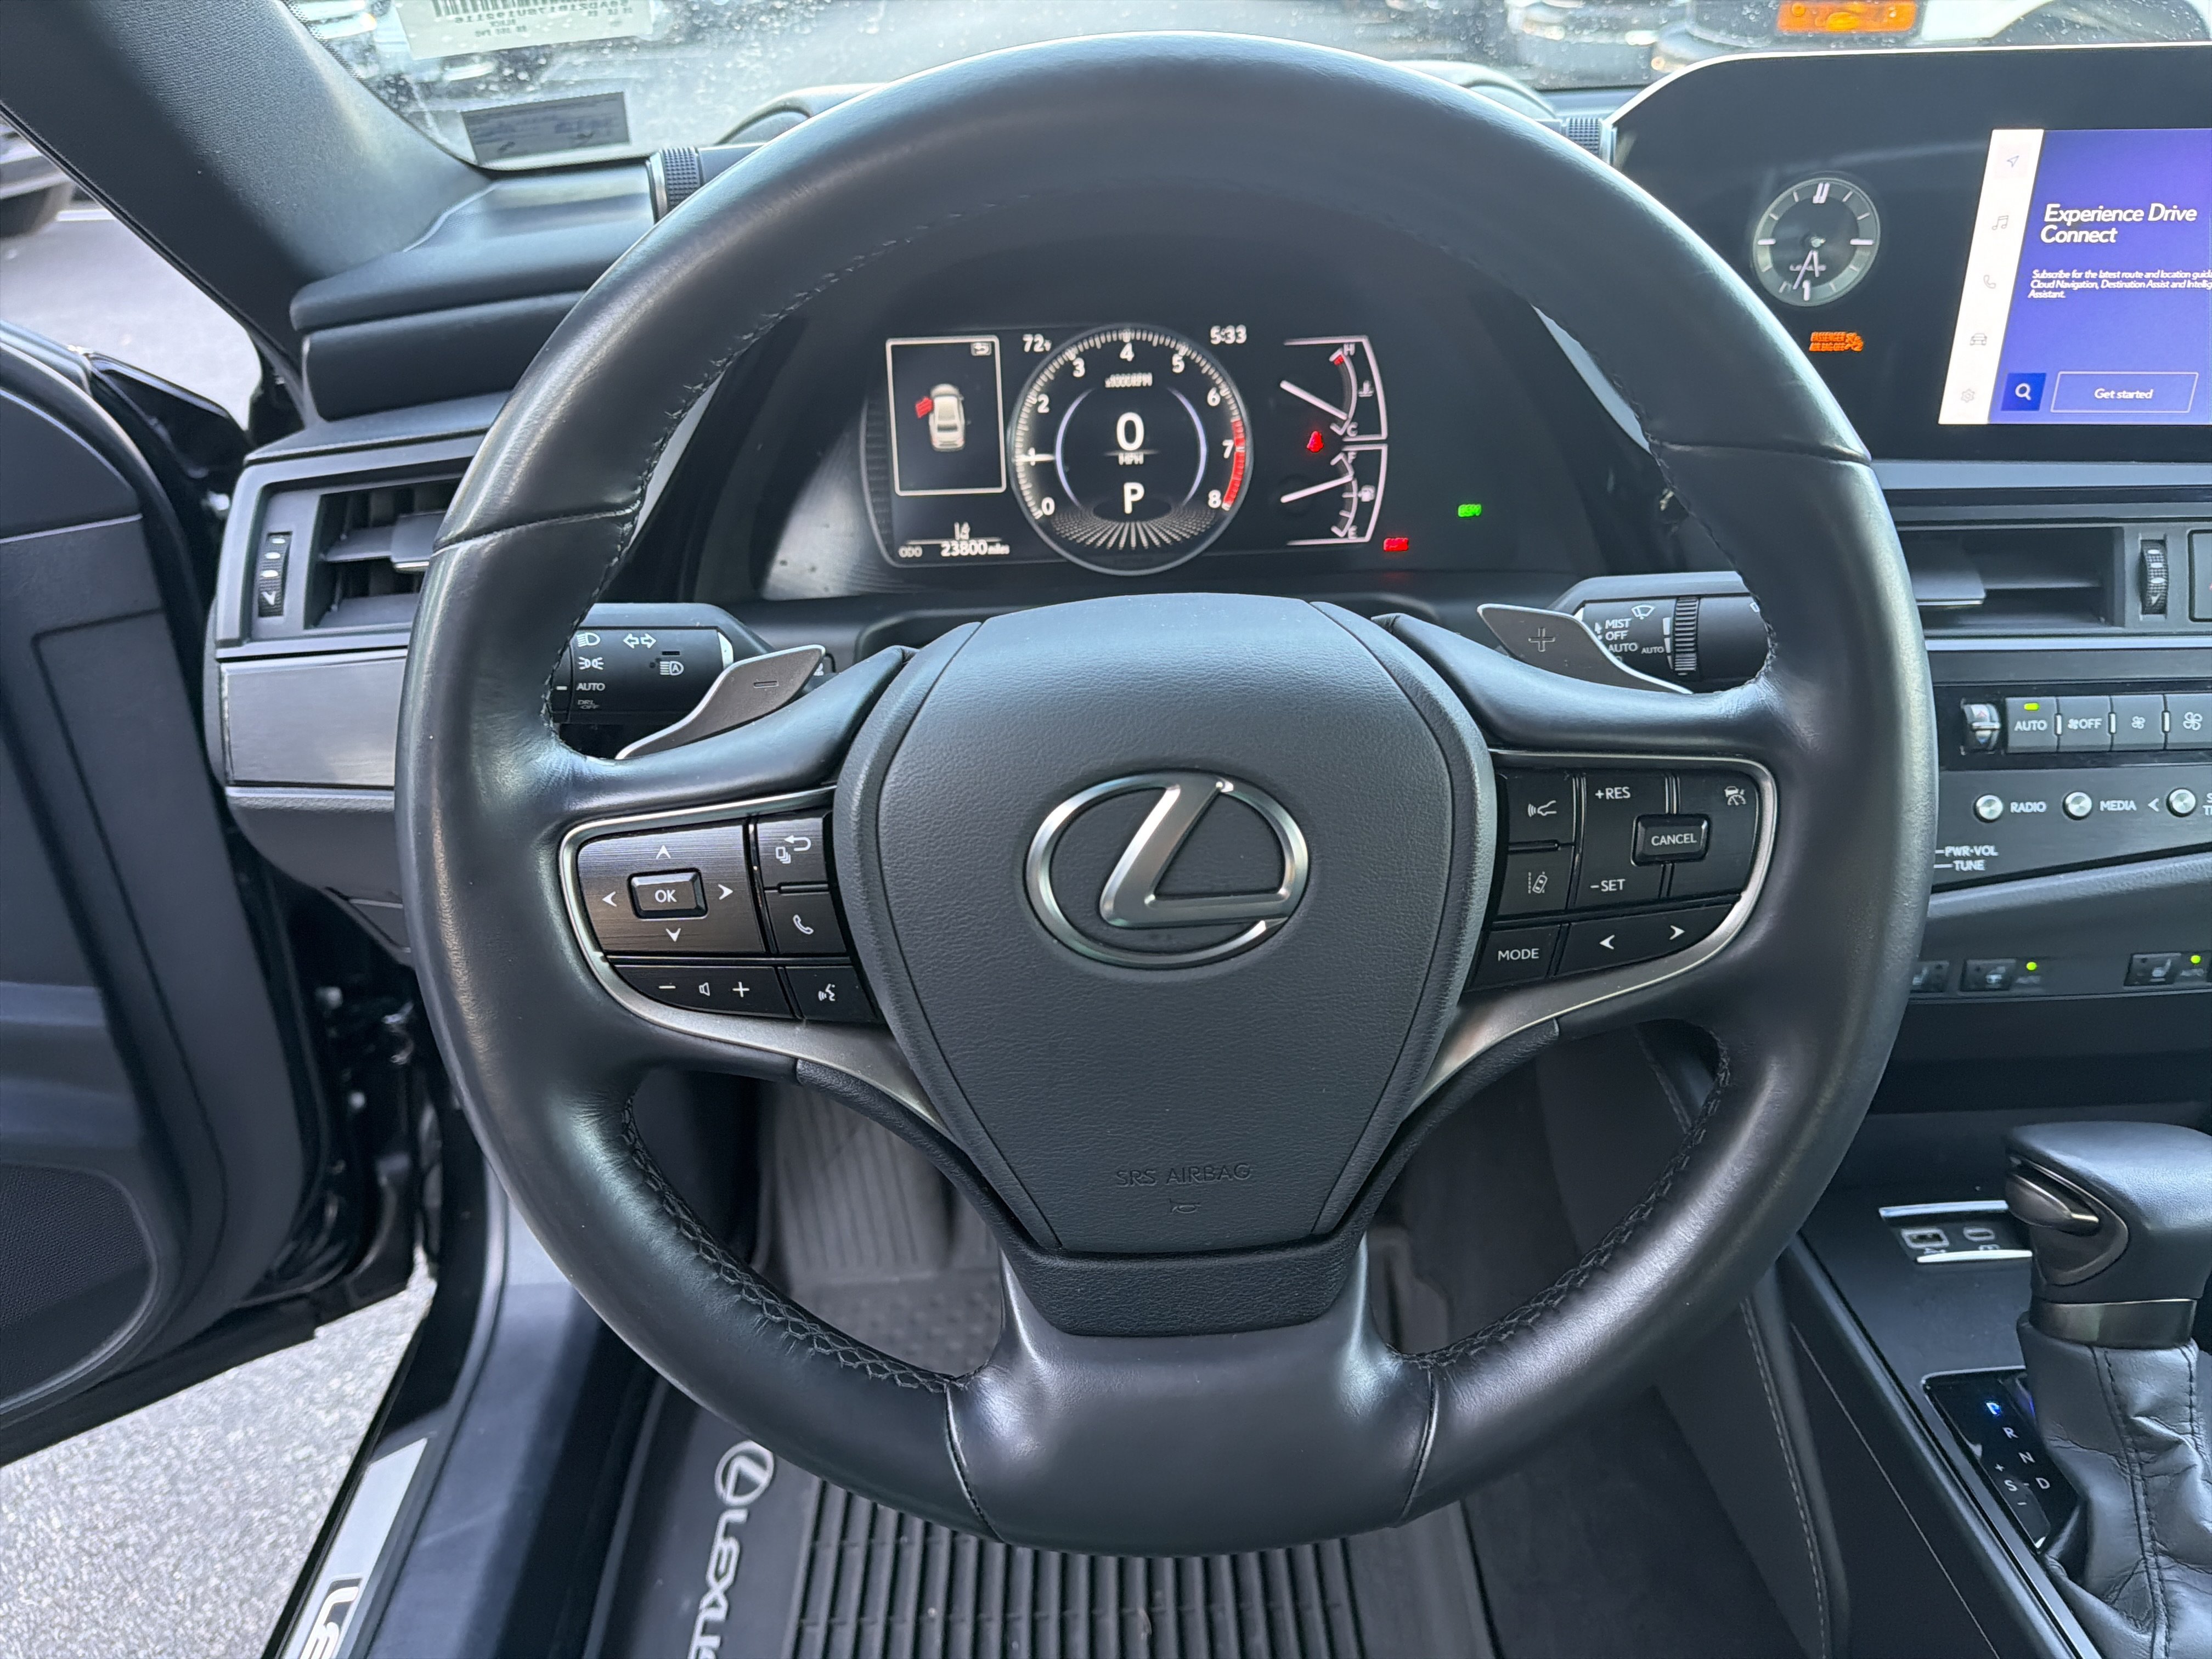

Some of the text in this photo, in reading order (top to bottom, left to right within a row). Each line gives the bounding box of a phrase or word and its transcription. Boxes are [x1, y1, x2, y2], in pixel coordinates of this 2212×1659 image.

[2044, 203, 2197, 225] Experience Drive
[2041, 225, 2118, 242] Connect
[2032, 269, 2070, 278] Subscribe
[2072, 269, 2084, 278] for
[2085, 269, 2097, 278] the
[2099, 269, 2120, 278] latest
[2145, 269, 2160, 278] and
[2161, 269, 2191, 278] location
[2030, 280, 2055, 288] Cloud
[2056, 280, 2099, 290] Navigation,
[2101, 279, 2145, 288] Destination
[2146, 279, 2170, 288] Assist
[2170, 280, 2186, 288] and
[1211, 325, 1247, 344] 5:33
[1120, 343, 1134, 361] 4
[1073, 358, 1086, 377] 3
[1172, 354, 1184, 373] 5
[1207, 387, 1221, 407] 6
[2094, 388, 2153, 399] Get started
[1037, 394, 1049, 413] 2
[1116, 412, 1144, 451] 0
[1222, 439, 1234, 459] 7
[1124, 482, 1144, 514] P
[1208, 489, 1221, 509] 8
[1042, 496, 1055, 516] 0
[940, 539, 987, 556] 23800
[1605, 618, 1632, 629] MIST
[1605, 630, 1629, 641] OFF
[1608, 642, 1638, 653] AUTO
[1641, 646, 1664, 654] AUTO
[576, 682, 606, 691] AUTO
[2015, 720, 2047, 731] AUTO
[2079, 718, 2102, 729] OFF
[2011, 802, 2046, 813] RADIO
[2100, 800, 2137, 811] MEDIA
[1651, 833, 1697, 847] CANCEL
[1954, 860, 1986, 871] TUNE
[654, 889, 678, 903] OK
[1498, 948, 1539, 961] MODE
[1116, 1163, 1252, 1187] SRS AIRBAG
[2003, 1427, 2018, 1439] R
[2018, 1451, 2036, 1464] N
[2004, 1480, 2018, 1491] S
[2035, 1477, 2050, 1489] D
[688, 1508, 749, 1659] LEXU
